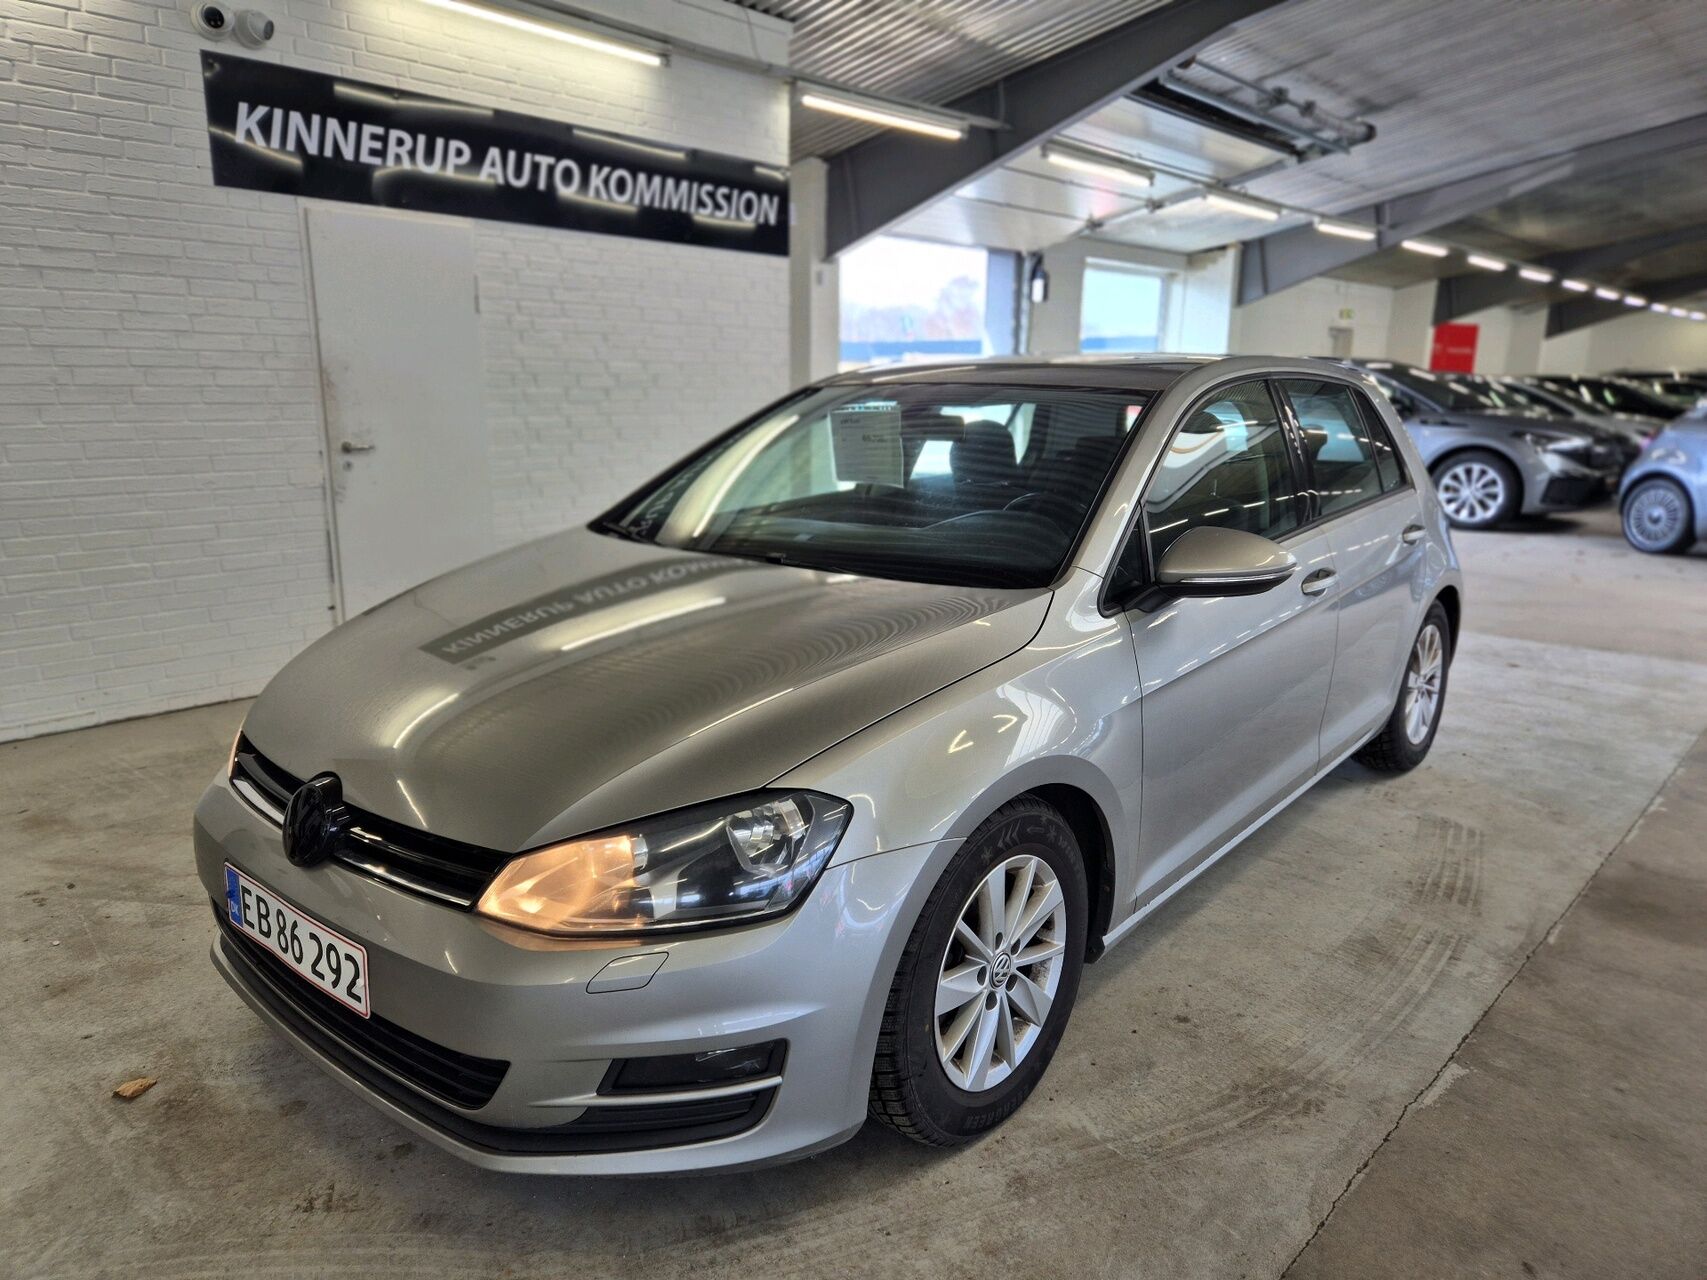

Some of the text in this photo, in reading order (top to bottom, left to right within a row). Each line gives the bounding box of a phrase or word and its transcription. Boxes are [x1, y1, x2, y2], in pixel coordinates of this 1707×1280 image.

[235, 101, 779, 226] KINNERUP AUTO KOMMISSION
[241, 884, 362, 1004] EB 86 292
